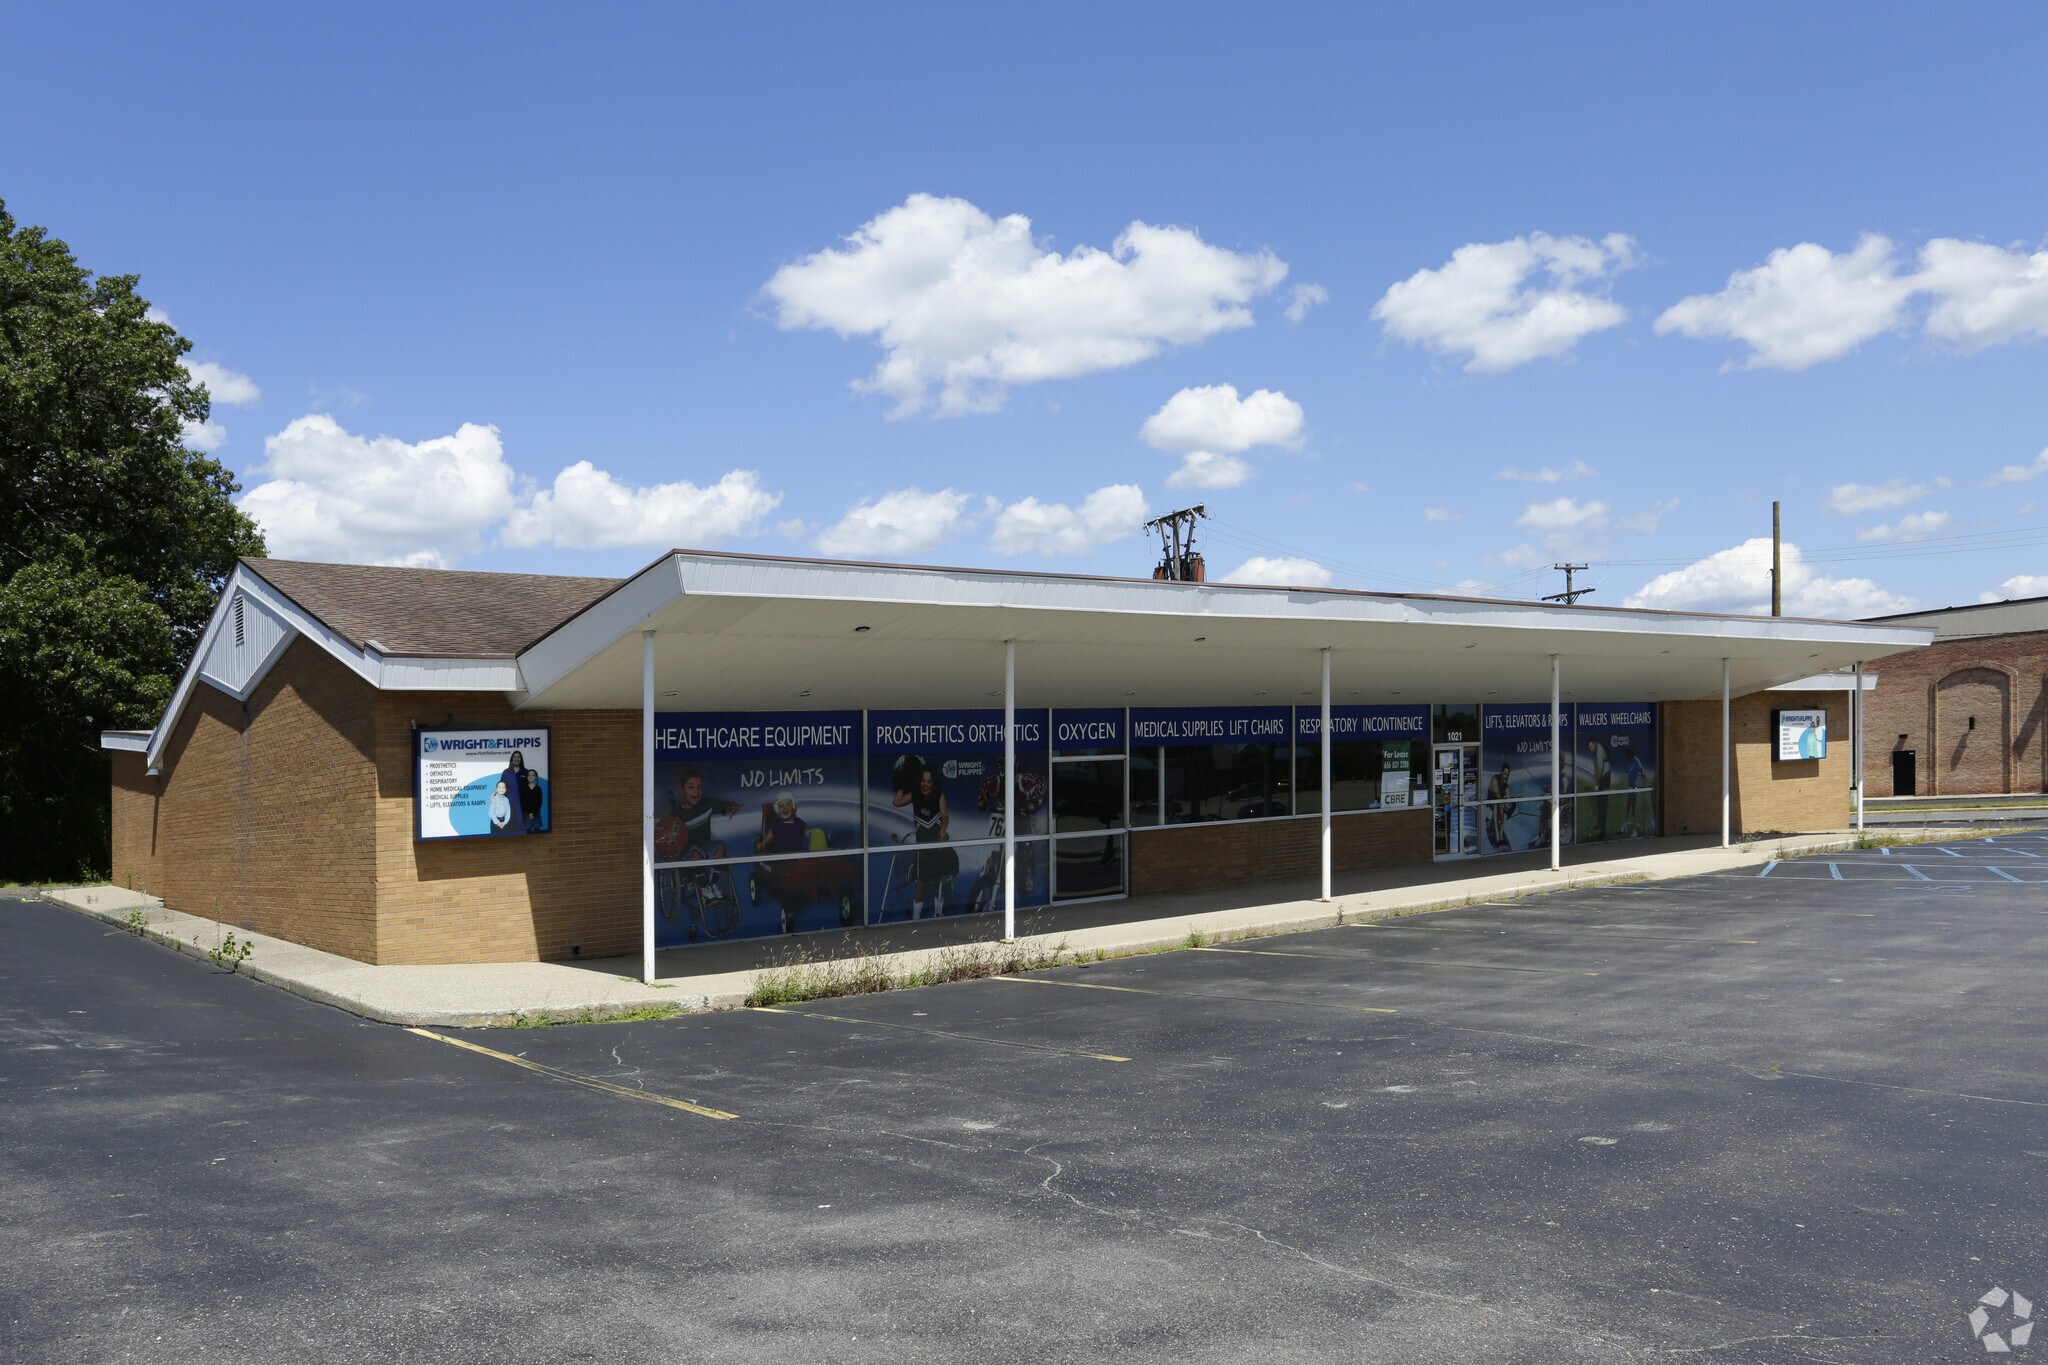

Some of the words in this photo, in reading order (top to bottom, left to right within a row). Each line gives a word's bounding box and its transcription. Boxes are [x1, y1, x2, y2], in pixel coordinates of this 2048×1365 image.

[1300, 717, 1358, 734] RESPIATORY
[1362, 716, 1423, 732] INCONTINENCE
[1485, 714, 1504, 730] LIFTS,
[1506, 713, 1541, 728] ELEVATORS
[1541, 713, 1547, 727] &
[1547, 713, 1568, 727] RPS
[1578, 712, 1608, 726] WALKERS
[1610, 711, 1652, 725] WHEELCHAIRS
[876, 724, 964, 744] PROSTHETICS
[968, 723, 1040, 743] ORTHTICS
[1058, 722, 1116, 741] OXYGEN
[1134, 720, 1179, 738] MEDICAL
[1182, 719, 1224, 737] SUPPLIES
[1229, 719, 1249, 736] LIFT
[1251, 718, 1284, 735] CHAIRS
[1447, 731, 1463, 741] 1021
[440, 737, 541, 750] WRIGHT&FILIPPIS
[655, 727, 760, 750] HEALTHCARE
[764, 725, 851, 747] EQUIPMENT
[1383, 750, 1393, 758] For
[1394, 750, 1409, 758] Lease
[1517, 741, 1528, 752] NO
[741, 770, 765, 788] NO
[769, 768, 824, 787] LIMITS
[1384, 793, 1406, 805] CBRE
